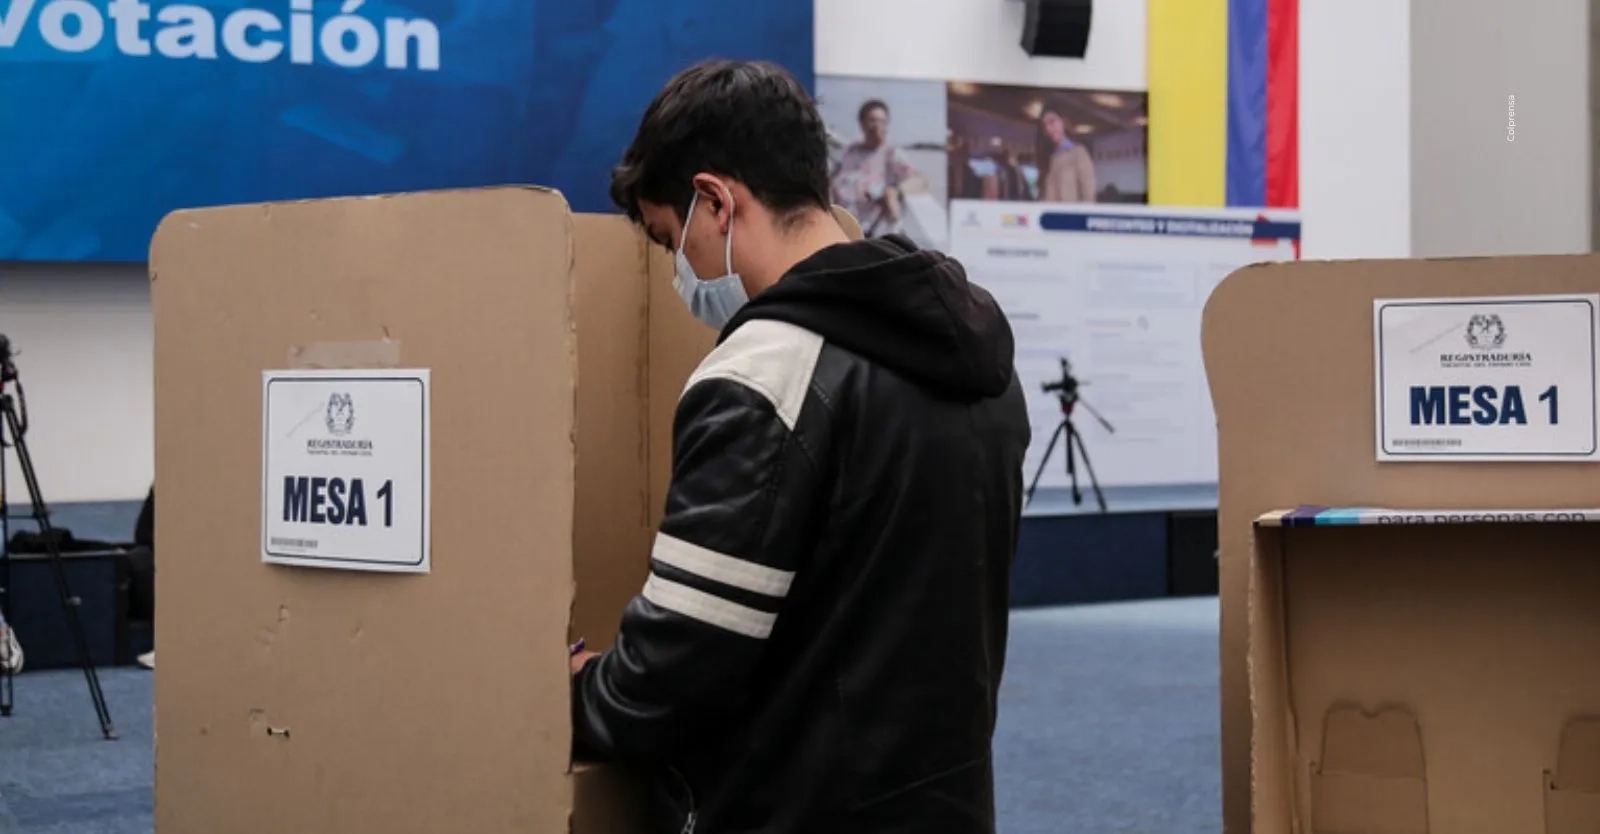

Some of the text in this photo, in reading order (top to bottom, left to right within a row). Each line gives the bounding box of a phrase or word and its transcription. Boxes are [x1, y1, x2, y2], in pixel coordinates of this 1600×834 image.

[1409, 384, 1559, 426] MESA 1
[282, 474, 394, 528] MESA 1
